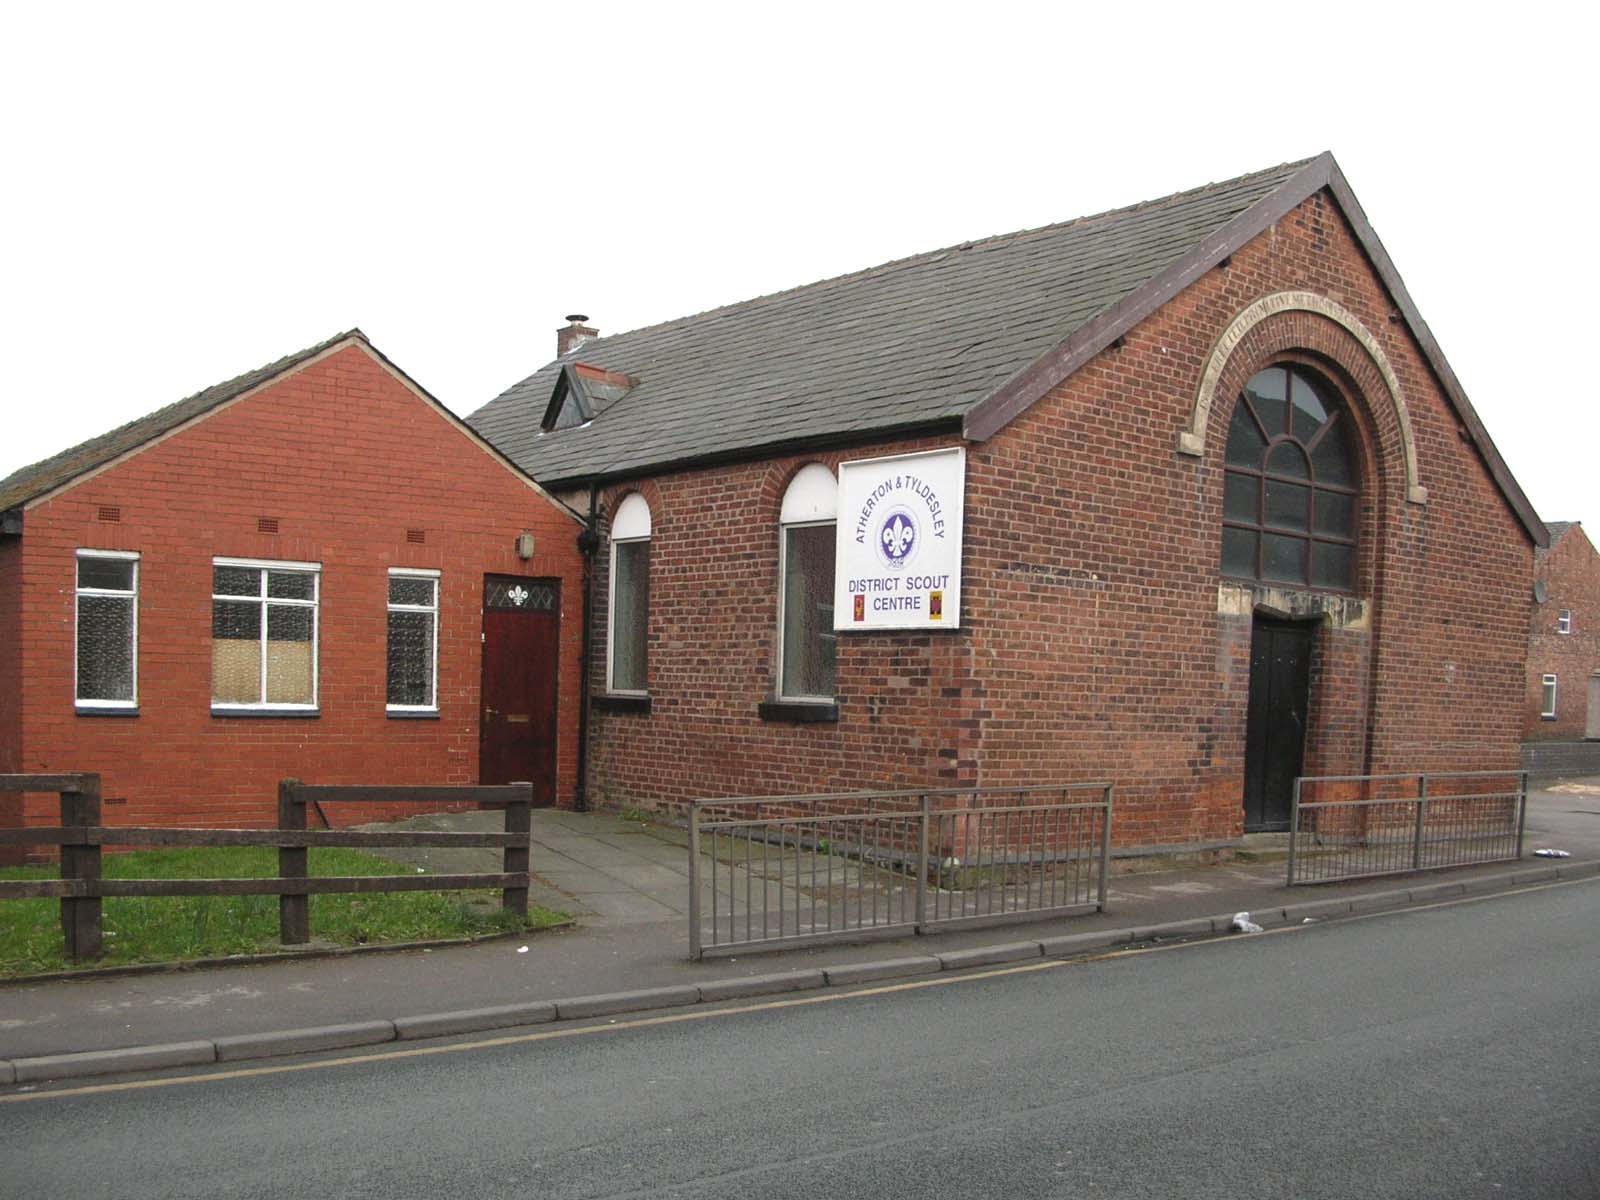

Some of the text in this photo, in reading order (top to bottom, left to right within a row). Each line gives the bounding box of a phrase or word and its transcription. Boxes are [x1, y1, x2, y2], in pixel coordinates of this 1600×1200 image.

[855, 475, 945, 544] ATHERTON & TYLDESLEY
[848, 575, 949, 593] DISTRICT SCOUT
[873, 596, 921, 611] CENTRE
